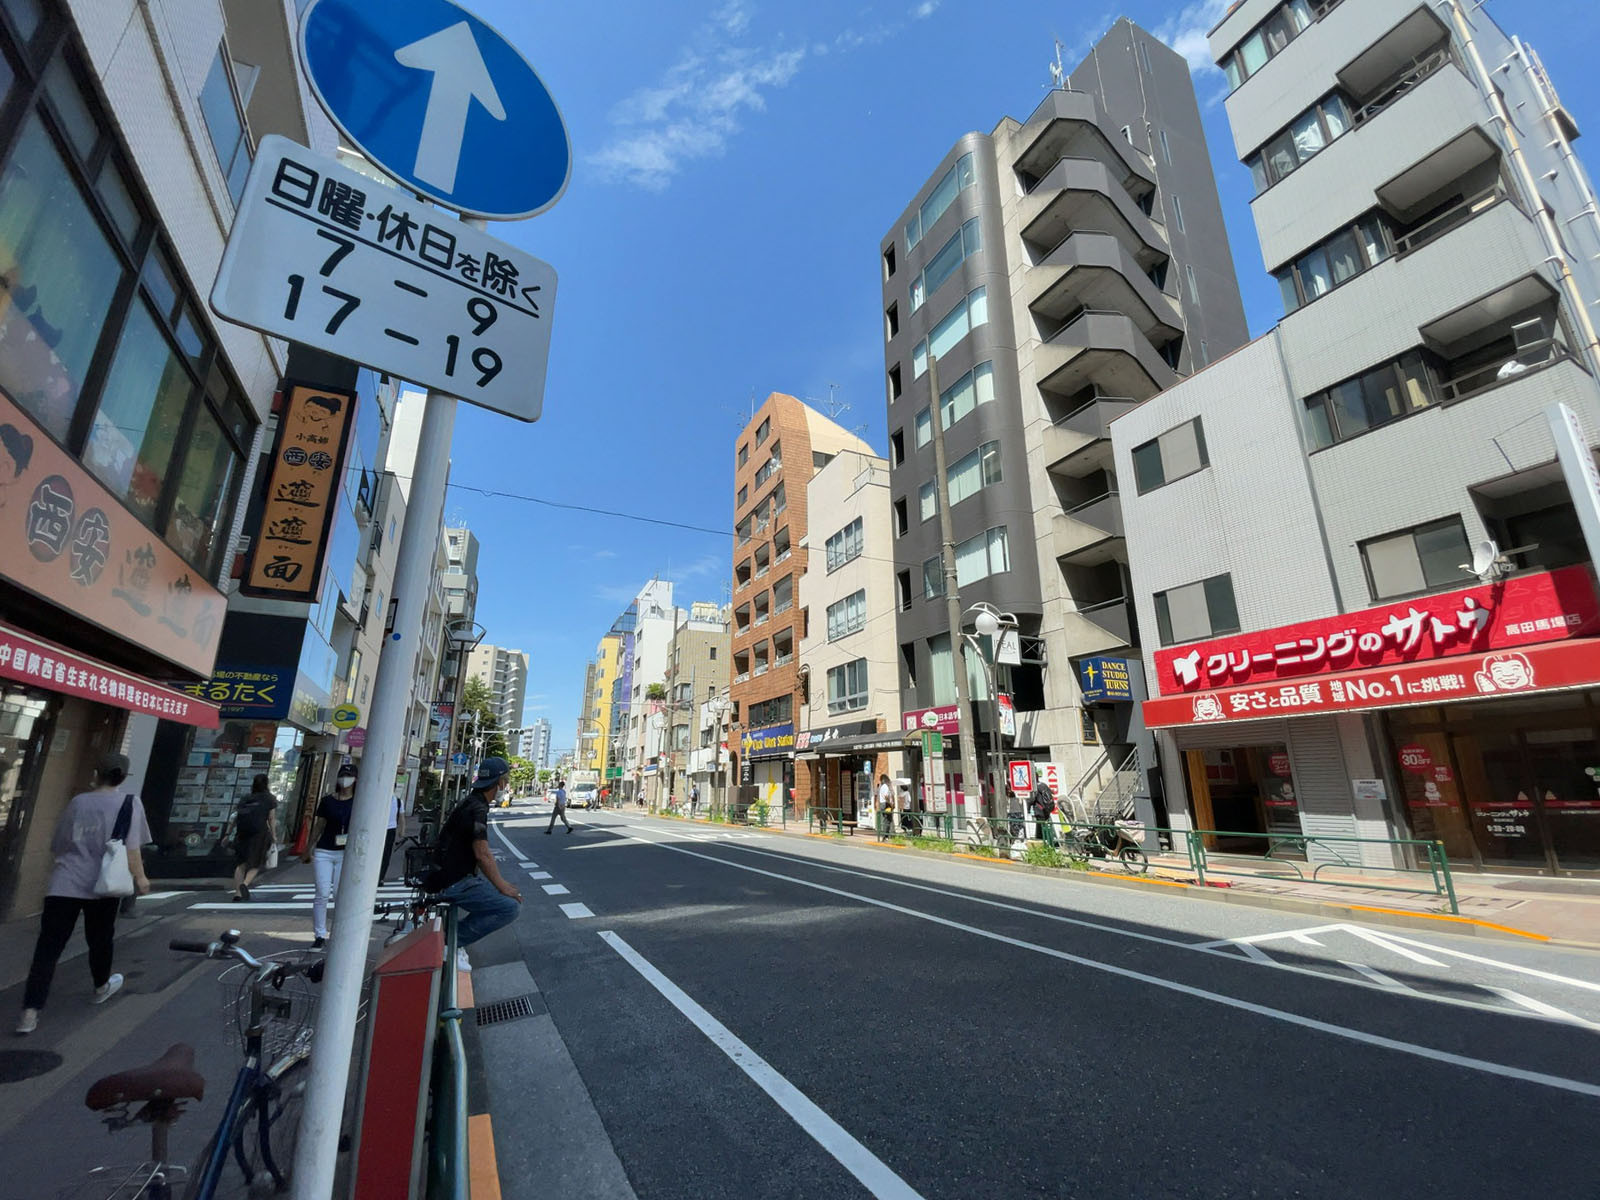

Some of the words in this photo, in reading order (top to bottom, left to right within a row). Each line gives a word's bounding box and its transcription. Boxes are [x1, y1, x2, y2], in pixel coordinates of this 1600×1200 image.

[271, 157, 542, 310] 日曜・休日を除く
[317, 228, 355, 277] 7
[466, 296, 498, 336] 9
[283, 273, 361, 335] 17
[444, 334, 503, 387] 19
[283, 447, 333, 471] 西安
[27, 475, 110, 587] 西安
[1207, 596, 1490, 676] クリーニングのサトウ
[1505, 613, 1581, 636] 高田馬場店
[213, 670, 278, 682] 場の不動産なら
[1101, 661, 1126, 671] DANCE
[1102, 670, 1128, 680] STUDIO
[1104, 679, 1129, 690] TURNS
[1230, 683, 1323, 713] 安さと品質
